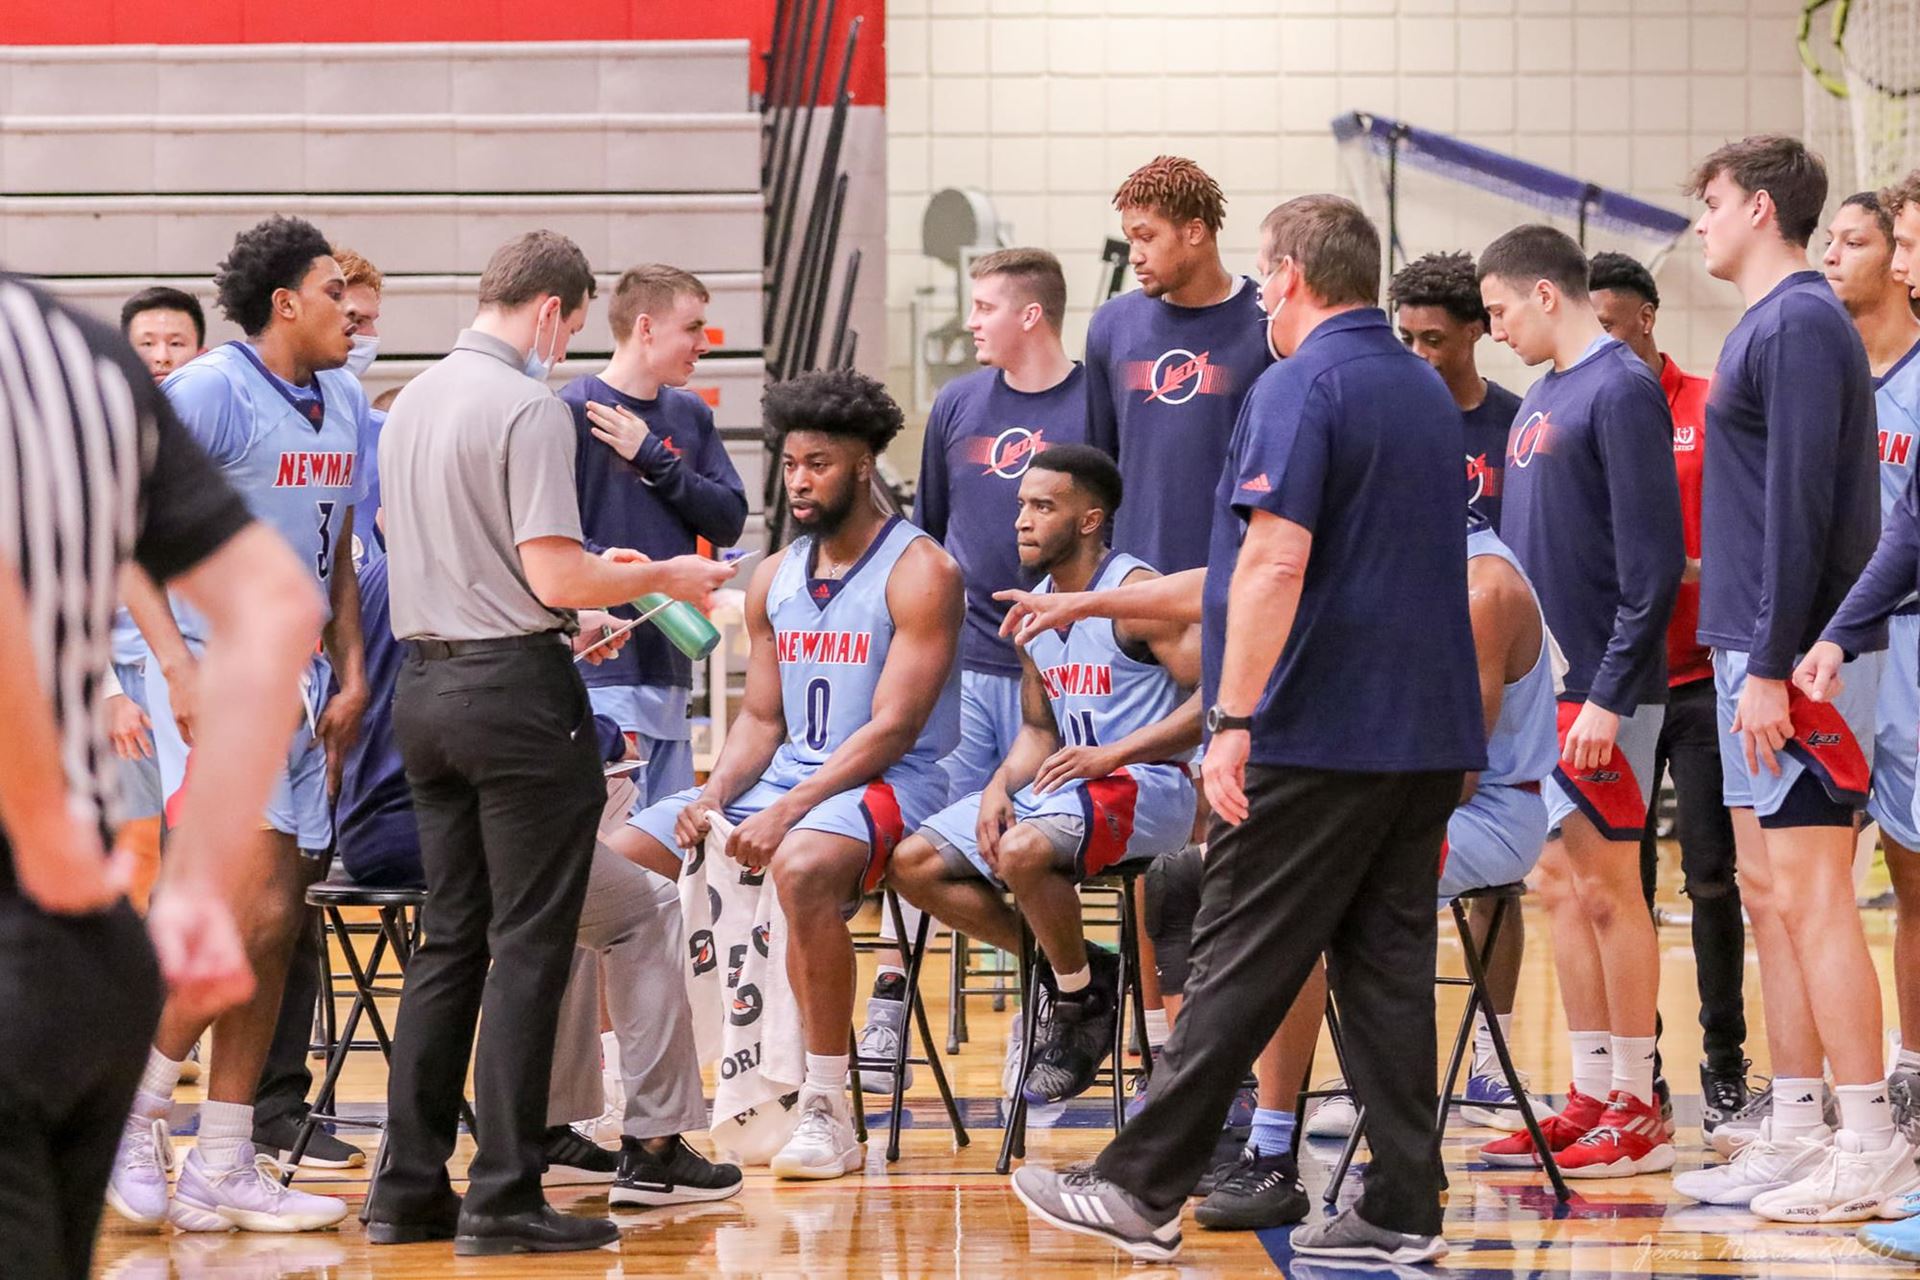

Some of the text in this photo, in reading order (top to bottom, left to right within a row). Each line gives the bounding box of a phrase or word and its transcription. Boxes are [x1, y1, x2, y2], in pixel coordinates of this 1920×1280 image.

[272, 452, 357, 488] NEWMA
[316, 500, 335, 581] 3
[777, 629, 871, 665] NEWMAN
[805, 676, 832, 752] 0
